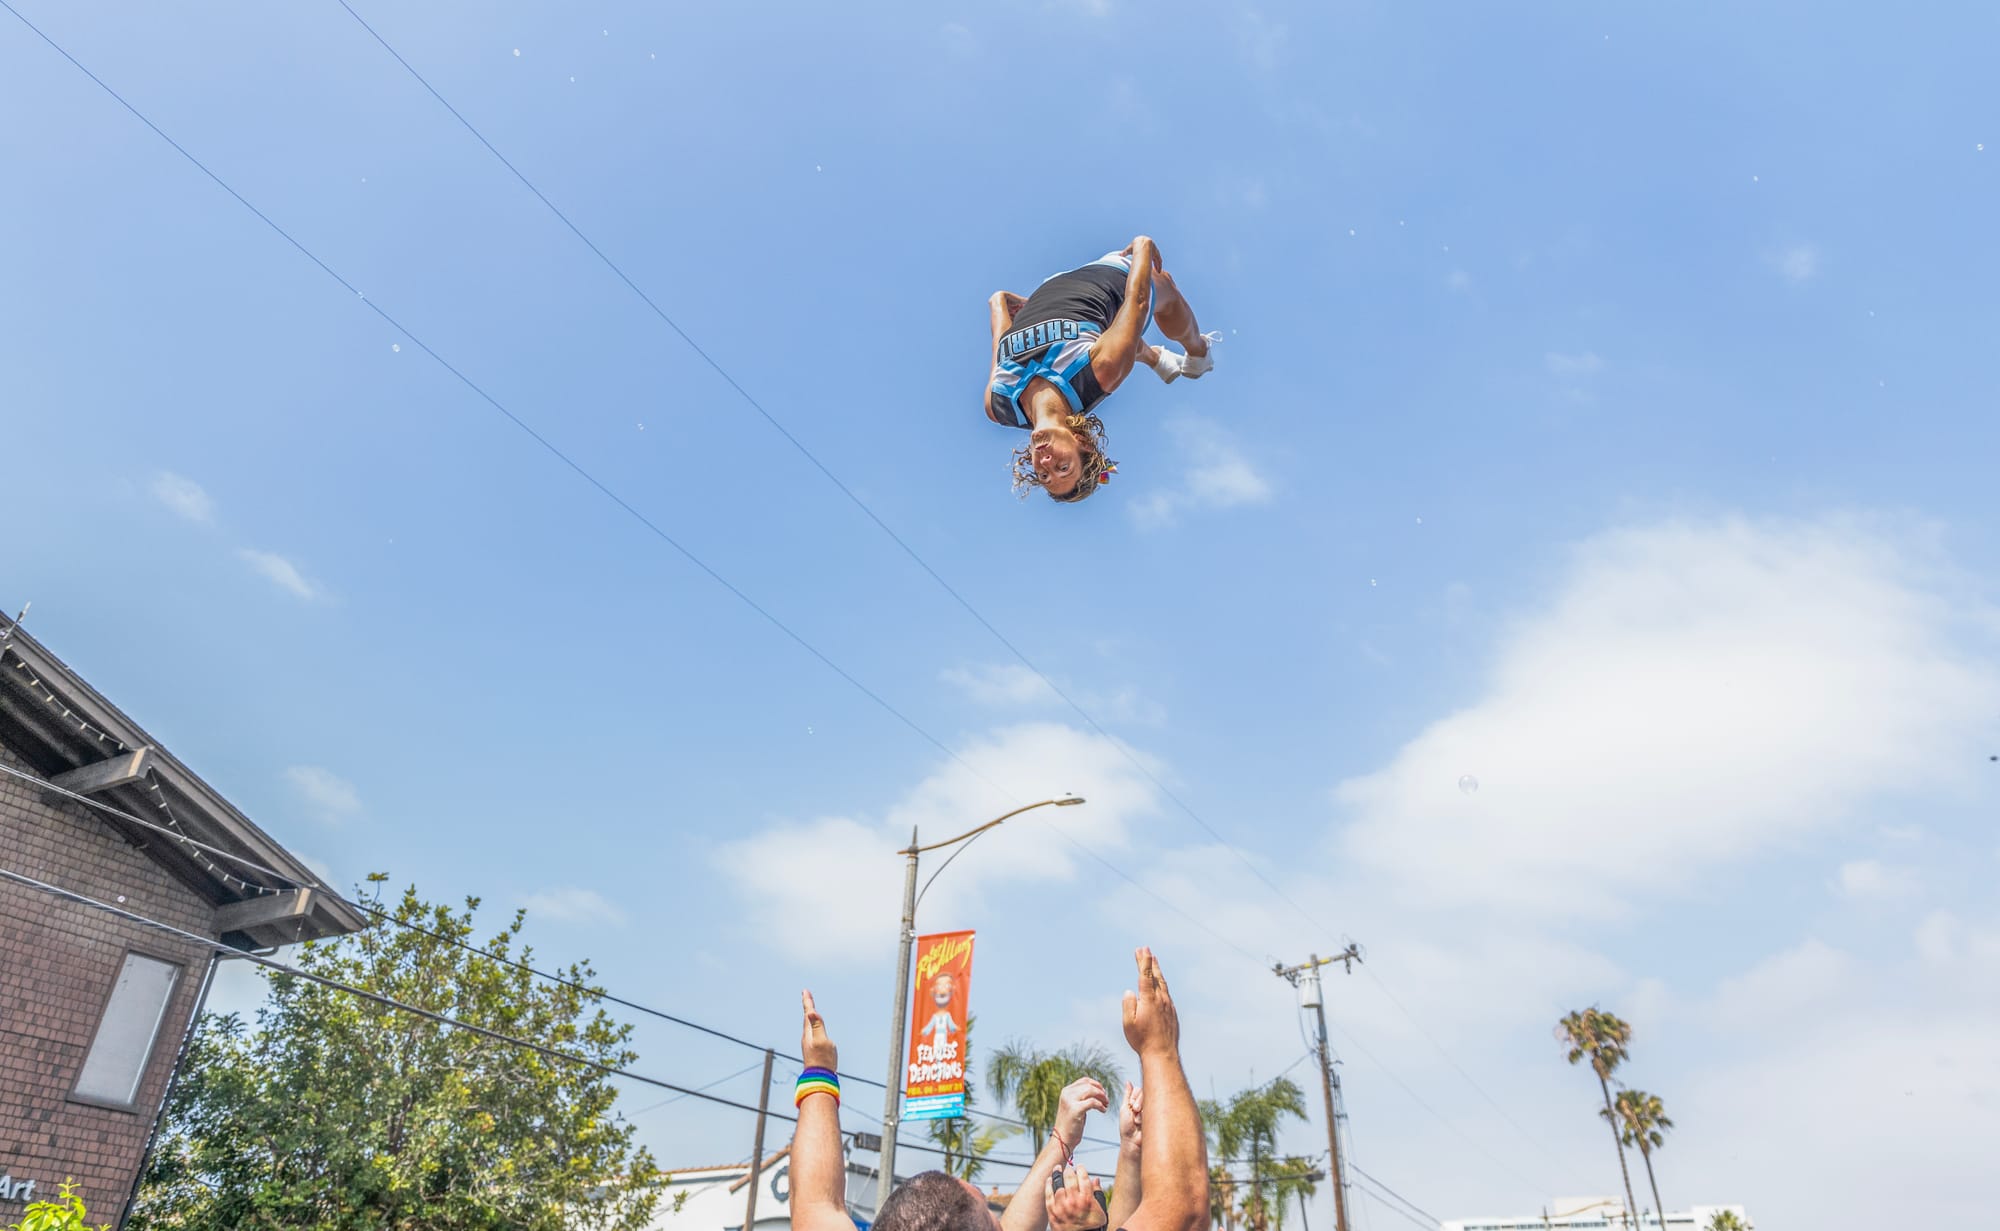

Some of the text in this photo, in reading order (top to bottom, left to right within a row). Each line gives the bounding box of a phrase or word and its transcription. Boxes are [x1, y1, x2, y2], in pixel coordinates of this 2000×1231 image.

[1011, 319, 1078, 354] CHEER
[909, 1061, 963, 1085] DEPICTIONS
[0, 1174, 36, 1201] Art
